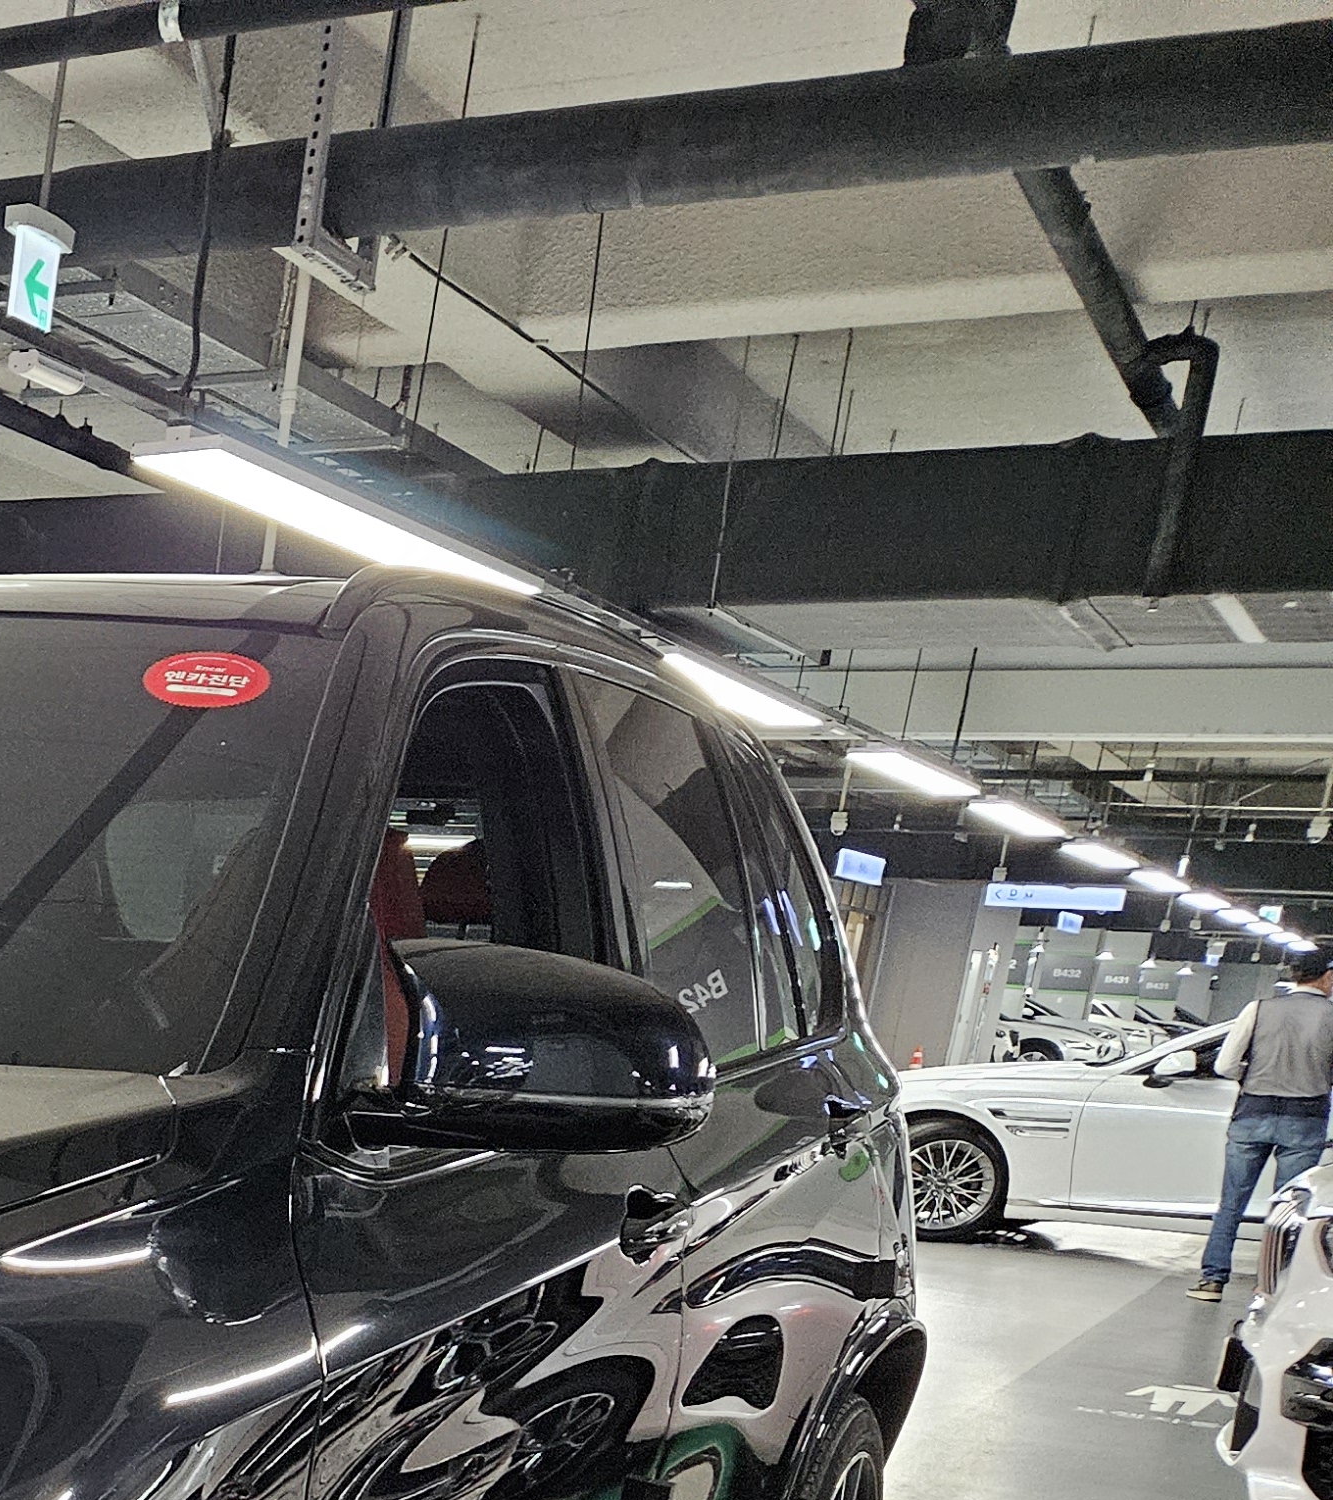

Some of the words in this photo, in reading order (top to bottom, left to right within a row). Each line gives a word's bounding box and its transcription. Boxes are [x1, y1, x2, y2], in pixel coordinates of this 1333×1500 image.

[164, 670, 251, 688] 엔카진단
[1053, 968, 1083, 979] B432
[1104, 975, 1130, 985] B431
